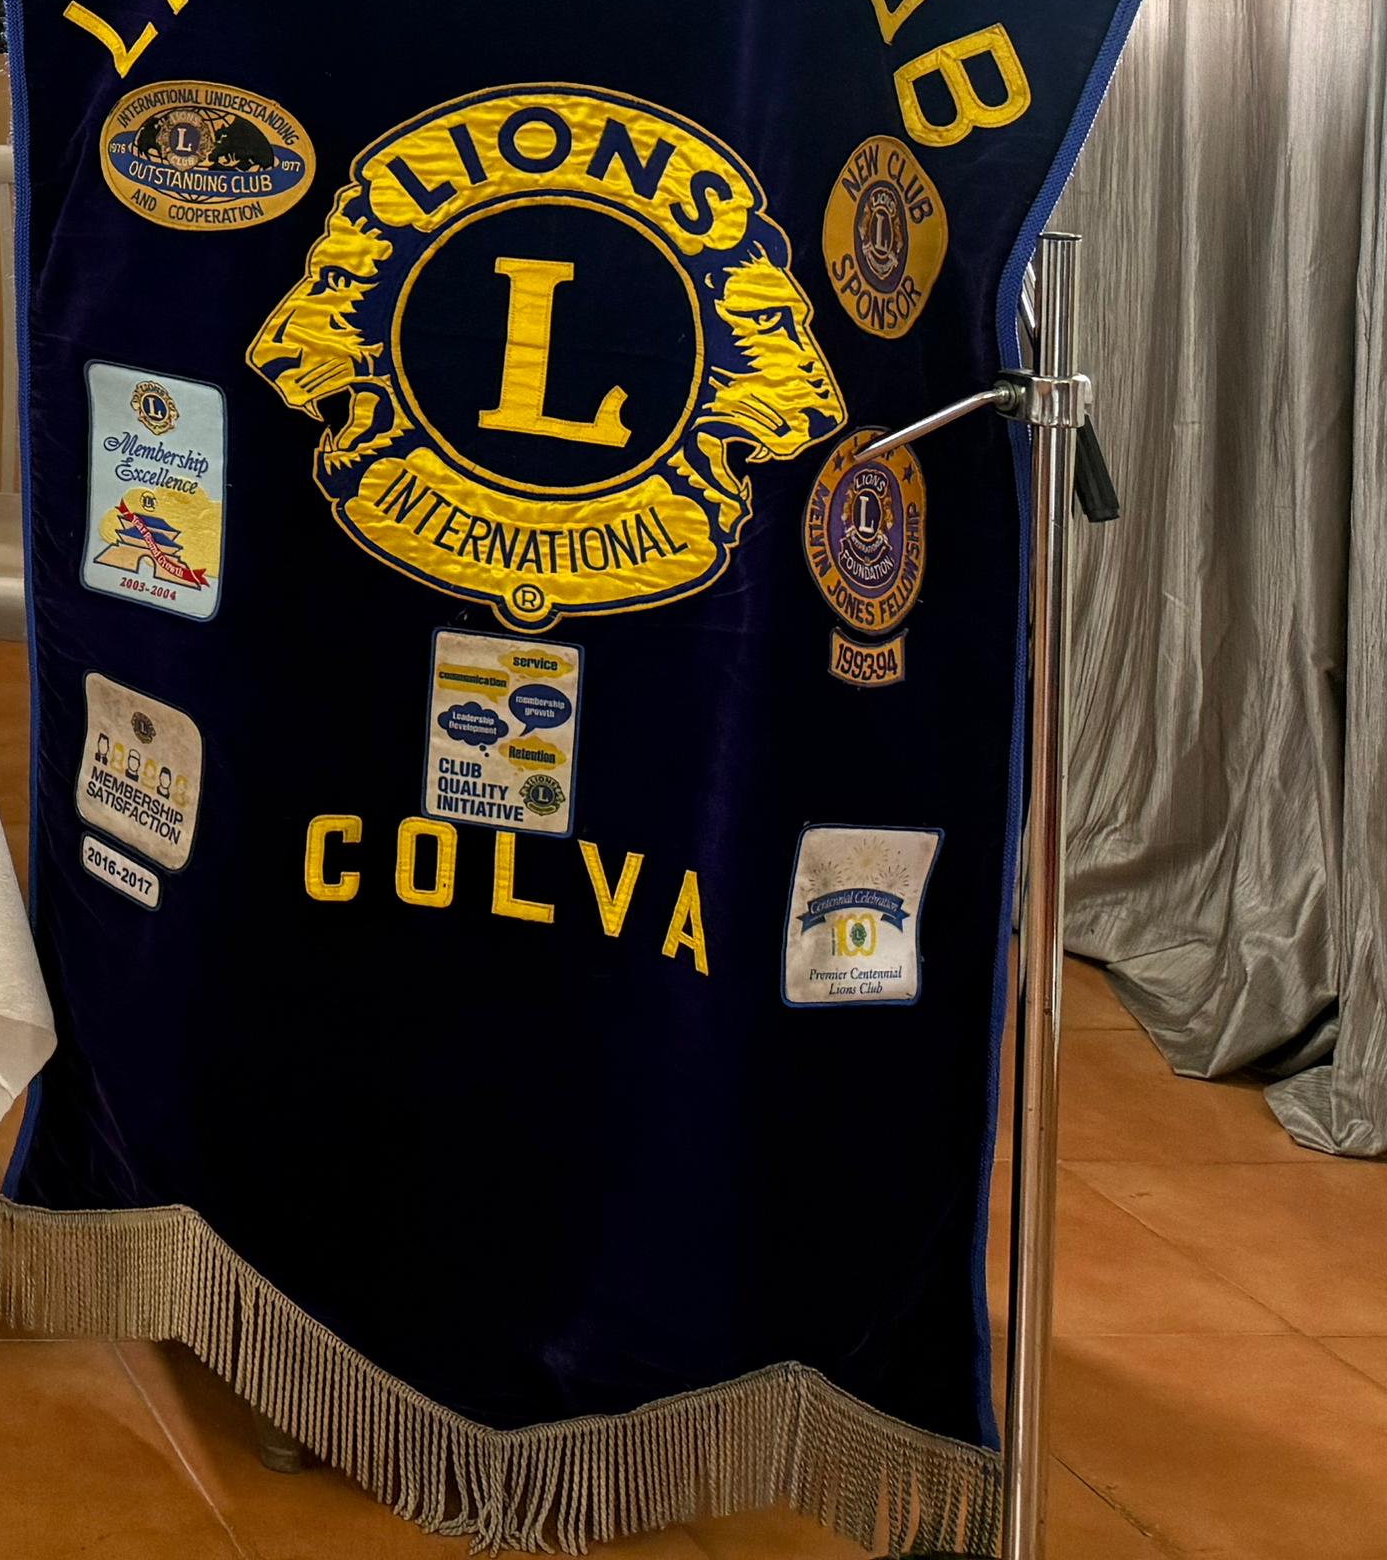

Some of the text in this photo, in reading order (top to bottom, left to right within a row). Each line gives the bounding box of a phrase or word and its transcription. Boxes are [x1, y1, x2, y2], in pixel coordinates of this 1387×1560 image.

[176, 128, 192, 151] L
[116, 89, 300, 224] INTERNATIONAL UNDERSTANDING AND COOPERATION
[385, 106, 734, 238] LIONS
[129, 160, 273, 193] OUTSTANDING CLUB
[841, 144, 880, 202] NEW
[887, 150, 934, 224] CLUB
[832, 253, 923, 330] SPONSOR
[478, 257, 632, 448] L
[103, 431, 209, 478] Membership
[115, 456, 198, 495] Excellence
[856, 473, 886, 493] LIONS
[378, 467, 689, 575] INTERNATIONAL
[859, 495, 875, 534] L
[809, 481, 920, 627] MELVIN JONES FELLOWSHIP
[841, 549, 895, 581] FOUNDATION
[118, 576, 177, 601] 2003-2004
[438, 671, 508, 688] communication
[513, 656, 559, 672] service
[452, 711, 496, 726] Leadership
[515, 695, 566, 710] membership
[524, 707, 556, 719] growth
[448, 720, 498, 736] Development
[438, 757, 483, 779] CLUB
[509, 745, 556, 764] Retention
[91, 765, 185, 826] MEMBERSHIP
[437, 776, 510, 801] QUALITY
[86, 780, 182, 845] SATISFACTION
[437, 793, 524, 822] INITIATIVE
[87, 846, 153, 896] 2016-2017
[304, 814, 710, 976] COLVA
[809, 964, 903, 981] Premier Centennial
[828, 981, 883, 996] Lions Club
